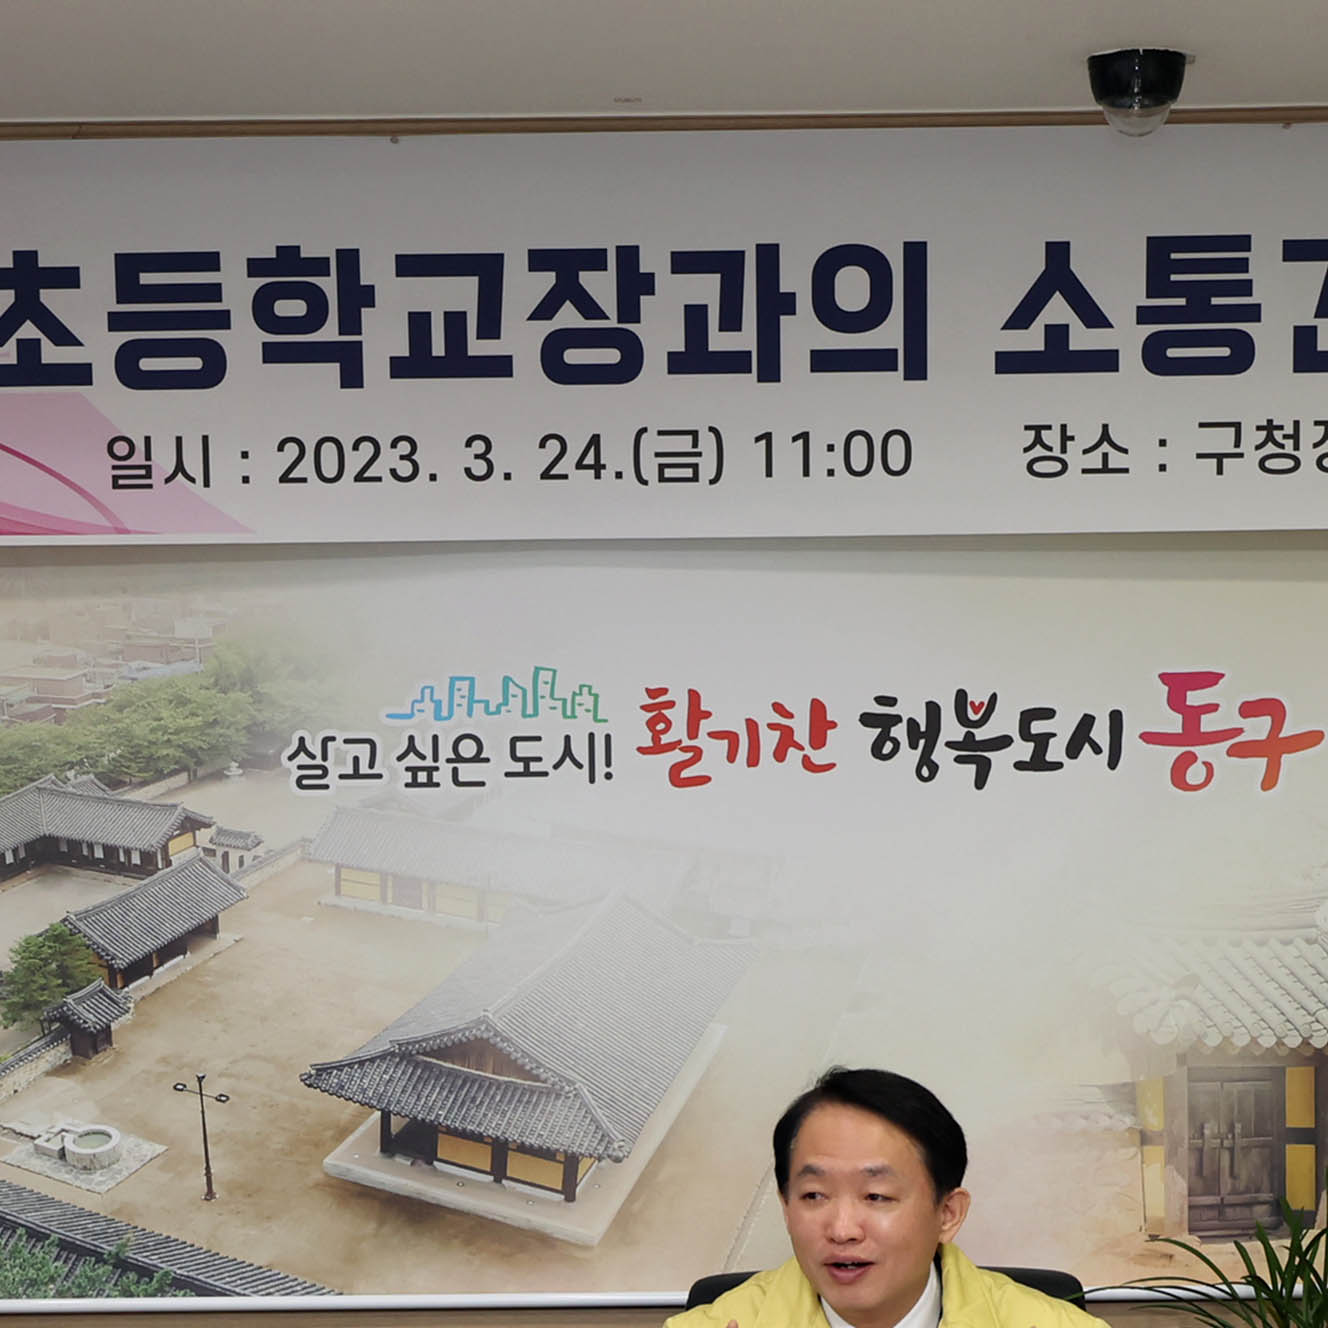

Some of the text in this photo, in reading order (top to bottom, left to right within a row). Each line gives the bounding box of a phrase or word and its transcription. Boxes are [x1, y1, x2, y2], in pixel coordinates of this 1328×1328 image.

[106, 434, 210, 489] 일시
[276, 434, 437, 483] 2023.
[463, 433, 512, 481] 3.
[538, 425, 723, 486] 24.(금)
[754, 428, 911, 477] 11:00
[1022, 423, 1130, 478] 장소
[287, 671, 1325, 791] 살고 싶은 도시! 활기찬 행복도시 동구
